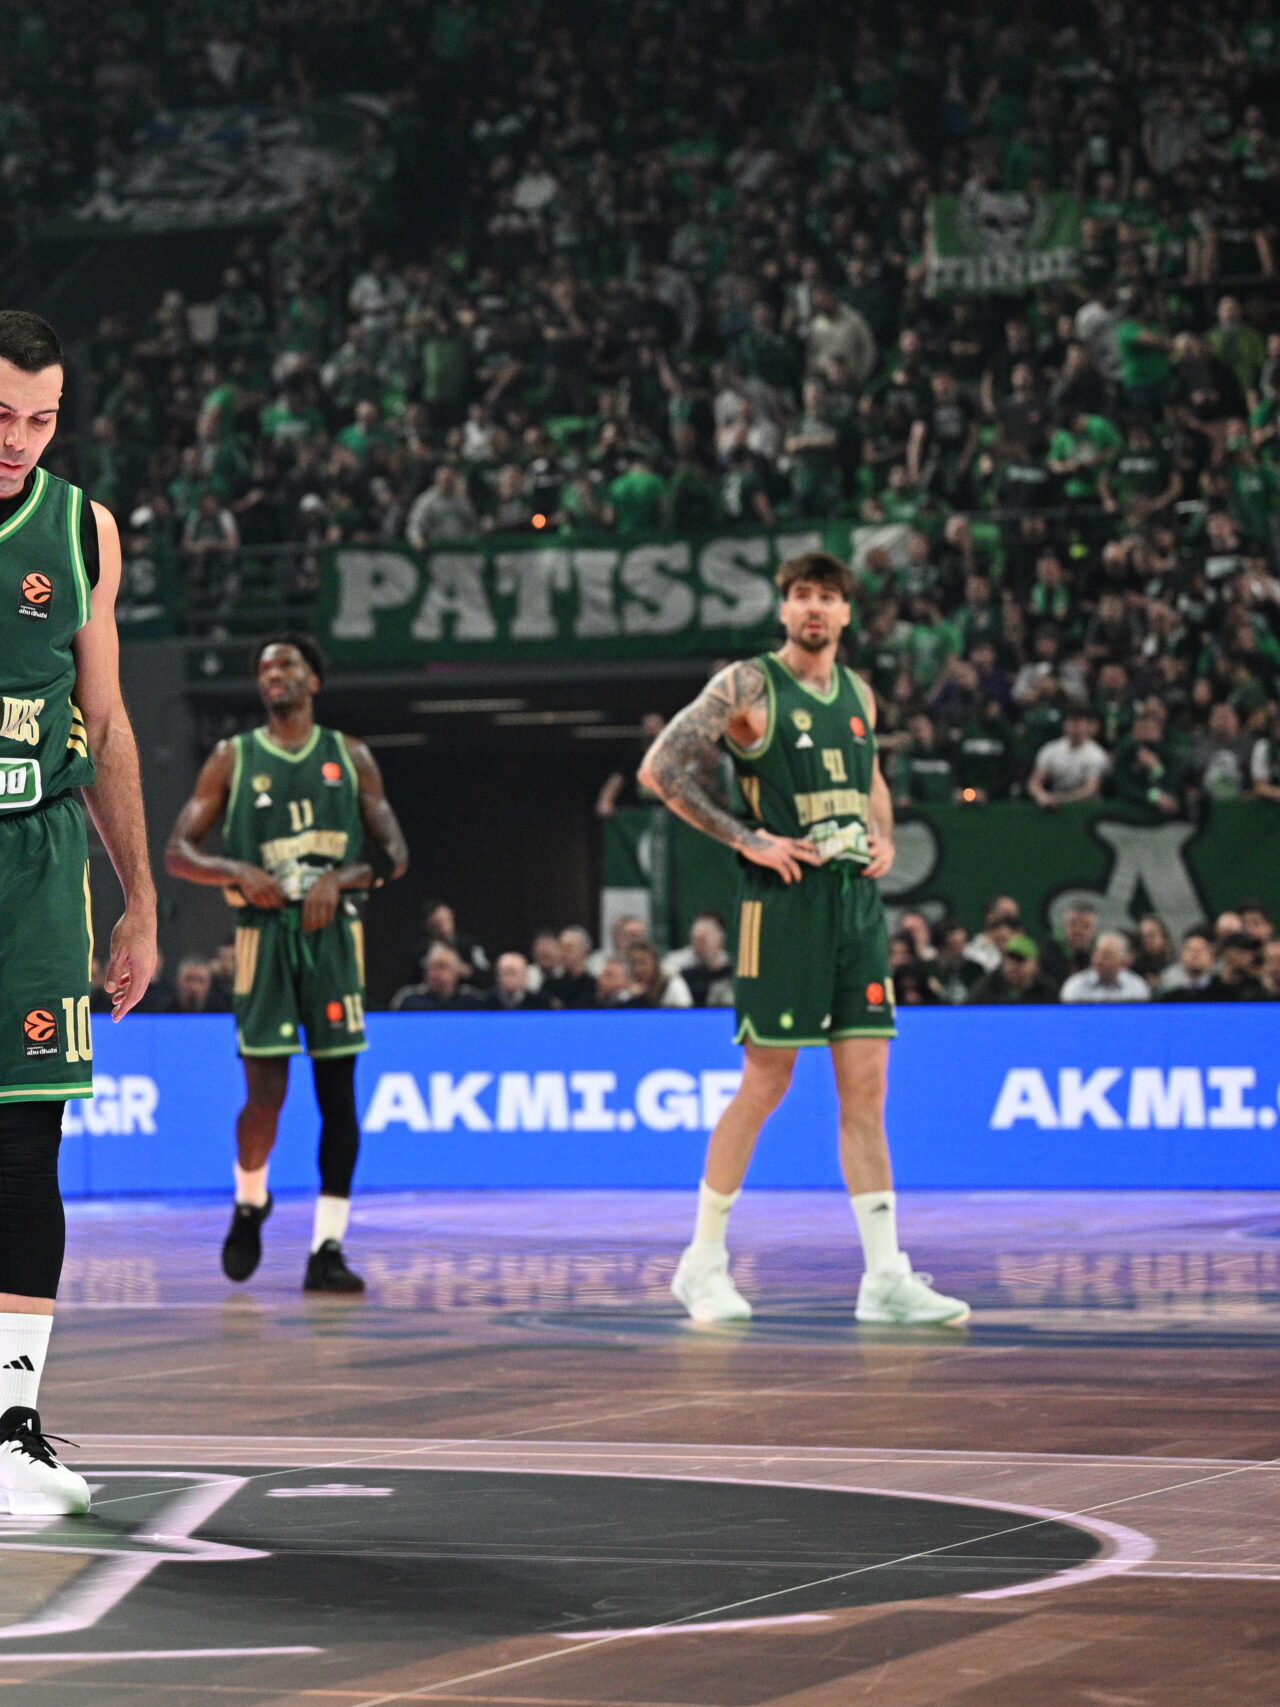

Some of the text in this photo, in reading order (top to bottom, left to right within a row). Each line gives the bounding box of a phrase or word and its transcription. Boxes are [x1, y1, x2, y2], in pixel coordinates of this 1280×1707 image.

[331, 530, 824, 642] PATISS
[62, 995, 93, 1062] 10
[988, 1066, 1280, 1130] AKMI.
